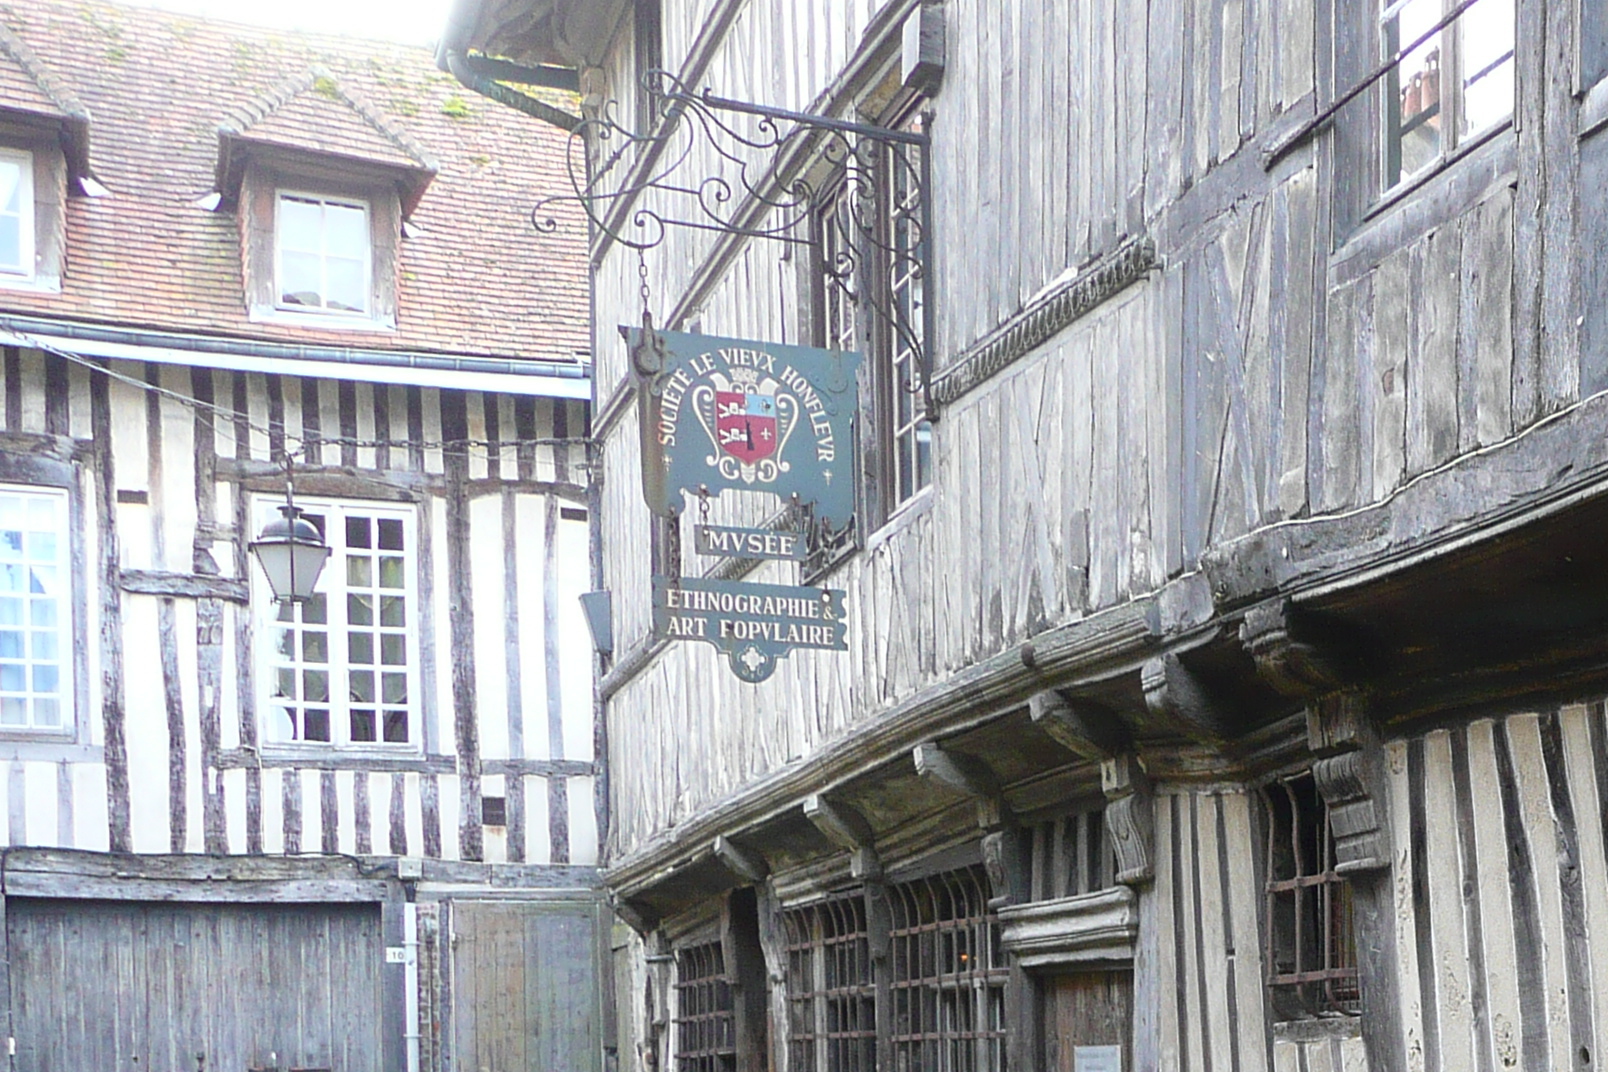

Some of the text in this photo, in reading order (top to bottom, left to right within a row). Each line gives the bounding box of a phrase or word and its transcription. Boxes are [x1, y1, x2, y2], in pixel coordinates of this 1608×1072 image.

[689, 352, 717, 376] LE
[718, 348, 777, 374] VIEVX
[780, 365, 836, 462] HONFLEVR
[666, 588, 819, 619] ETHNOGRAPHIE
[667, 616, 708, 637] ART
